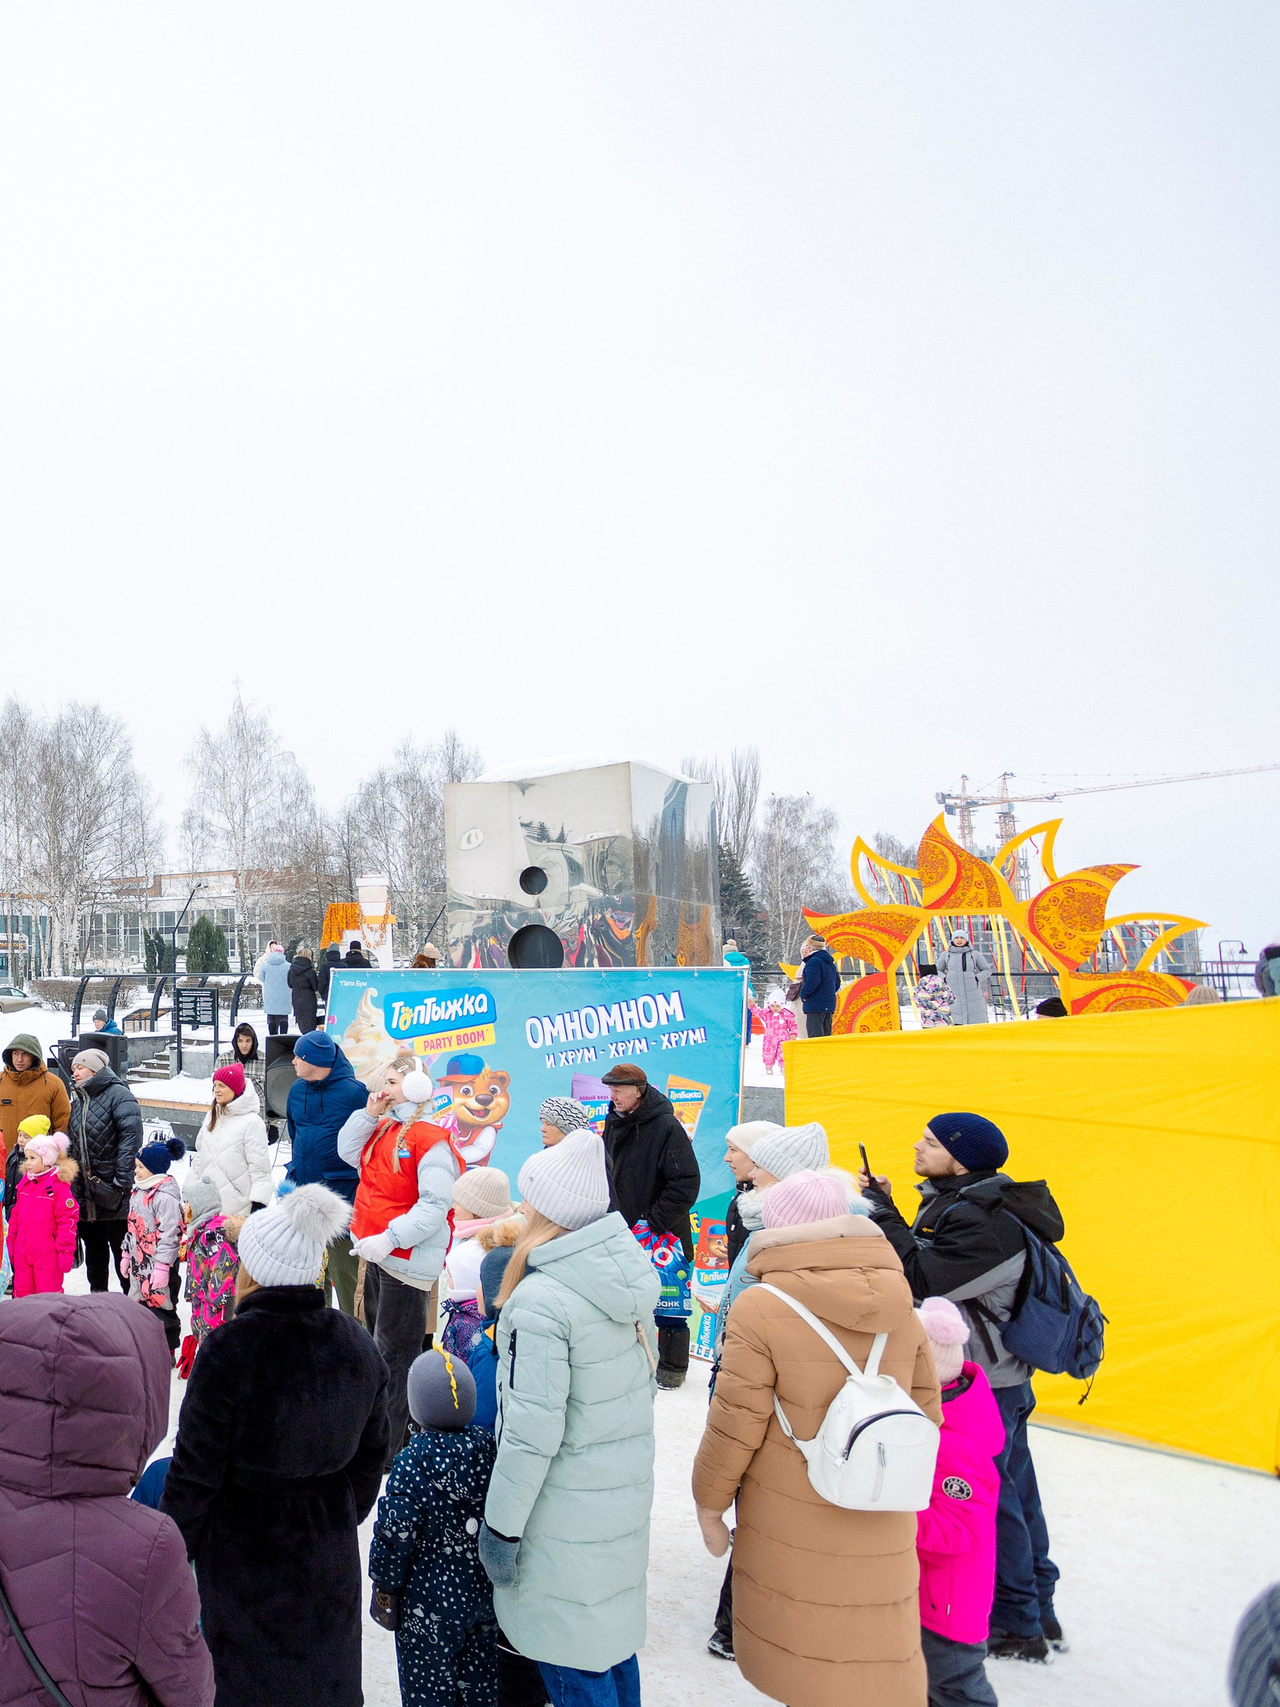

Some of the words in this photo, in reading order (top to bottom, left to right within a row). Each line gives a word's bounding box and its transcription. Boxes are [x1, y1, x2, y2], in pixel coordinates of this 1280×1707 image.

[525, 990, 686, 1049] ОМНОМНОМ
[423, 1035, 453, 1052] PARTY
[545, 1053, 557, 1069] И
[558, 1046, 597, 1067] ХРУМ
[607, 1037, 649, 1059] ХРУМ
[659, 1026, 708, 1050] ХРУМ!
